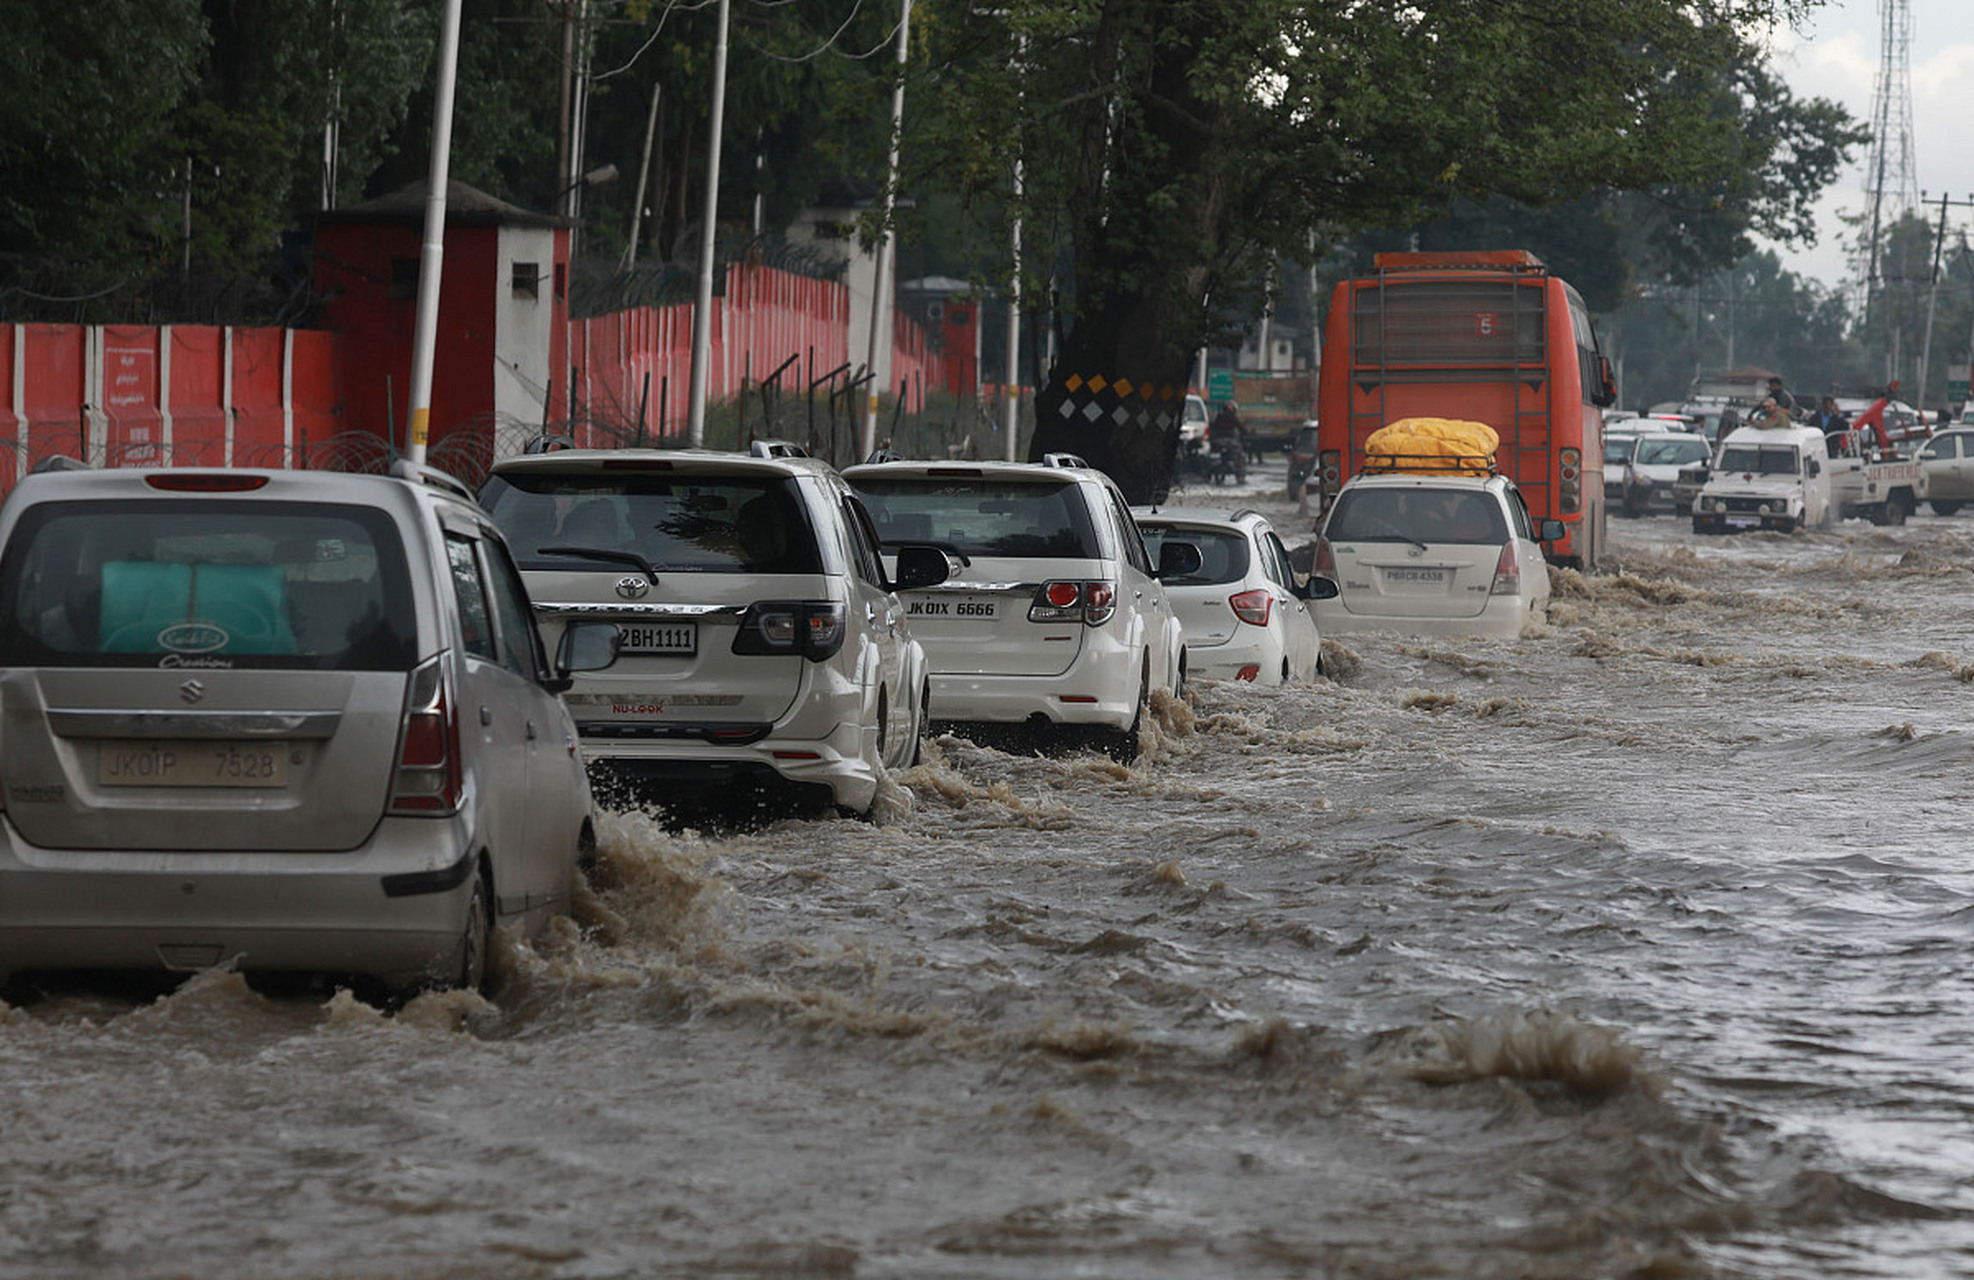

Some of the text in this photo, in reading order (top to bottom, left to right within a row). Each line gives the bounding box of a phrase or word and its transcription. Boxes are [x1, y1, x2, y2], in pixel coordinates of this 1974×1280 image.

[906, 603, 995, 616] JK01X 6666
[621, 629, 692, 648] 2BH1111
[612, 704, 664, 714] NU-LOOK
[214, 753, 275, 778] 7528
